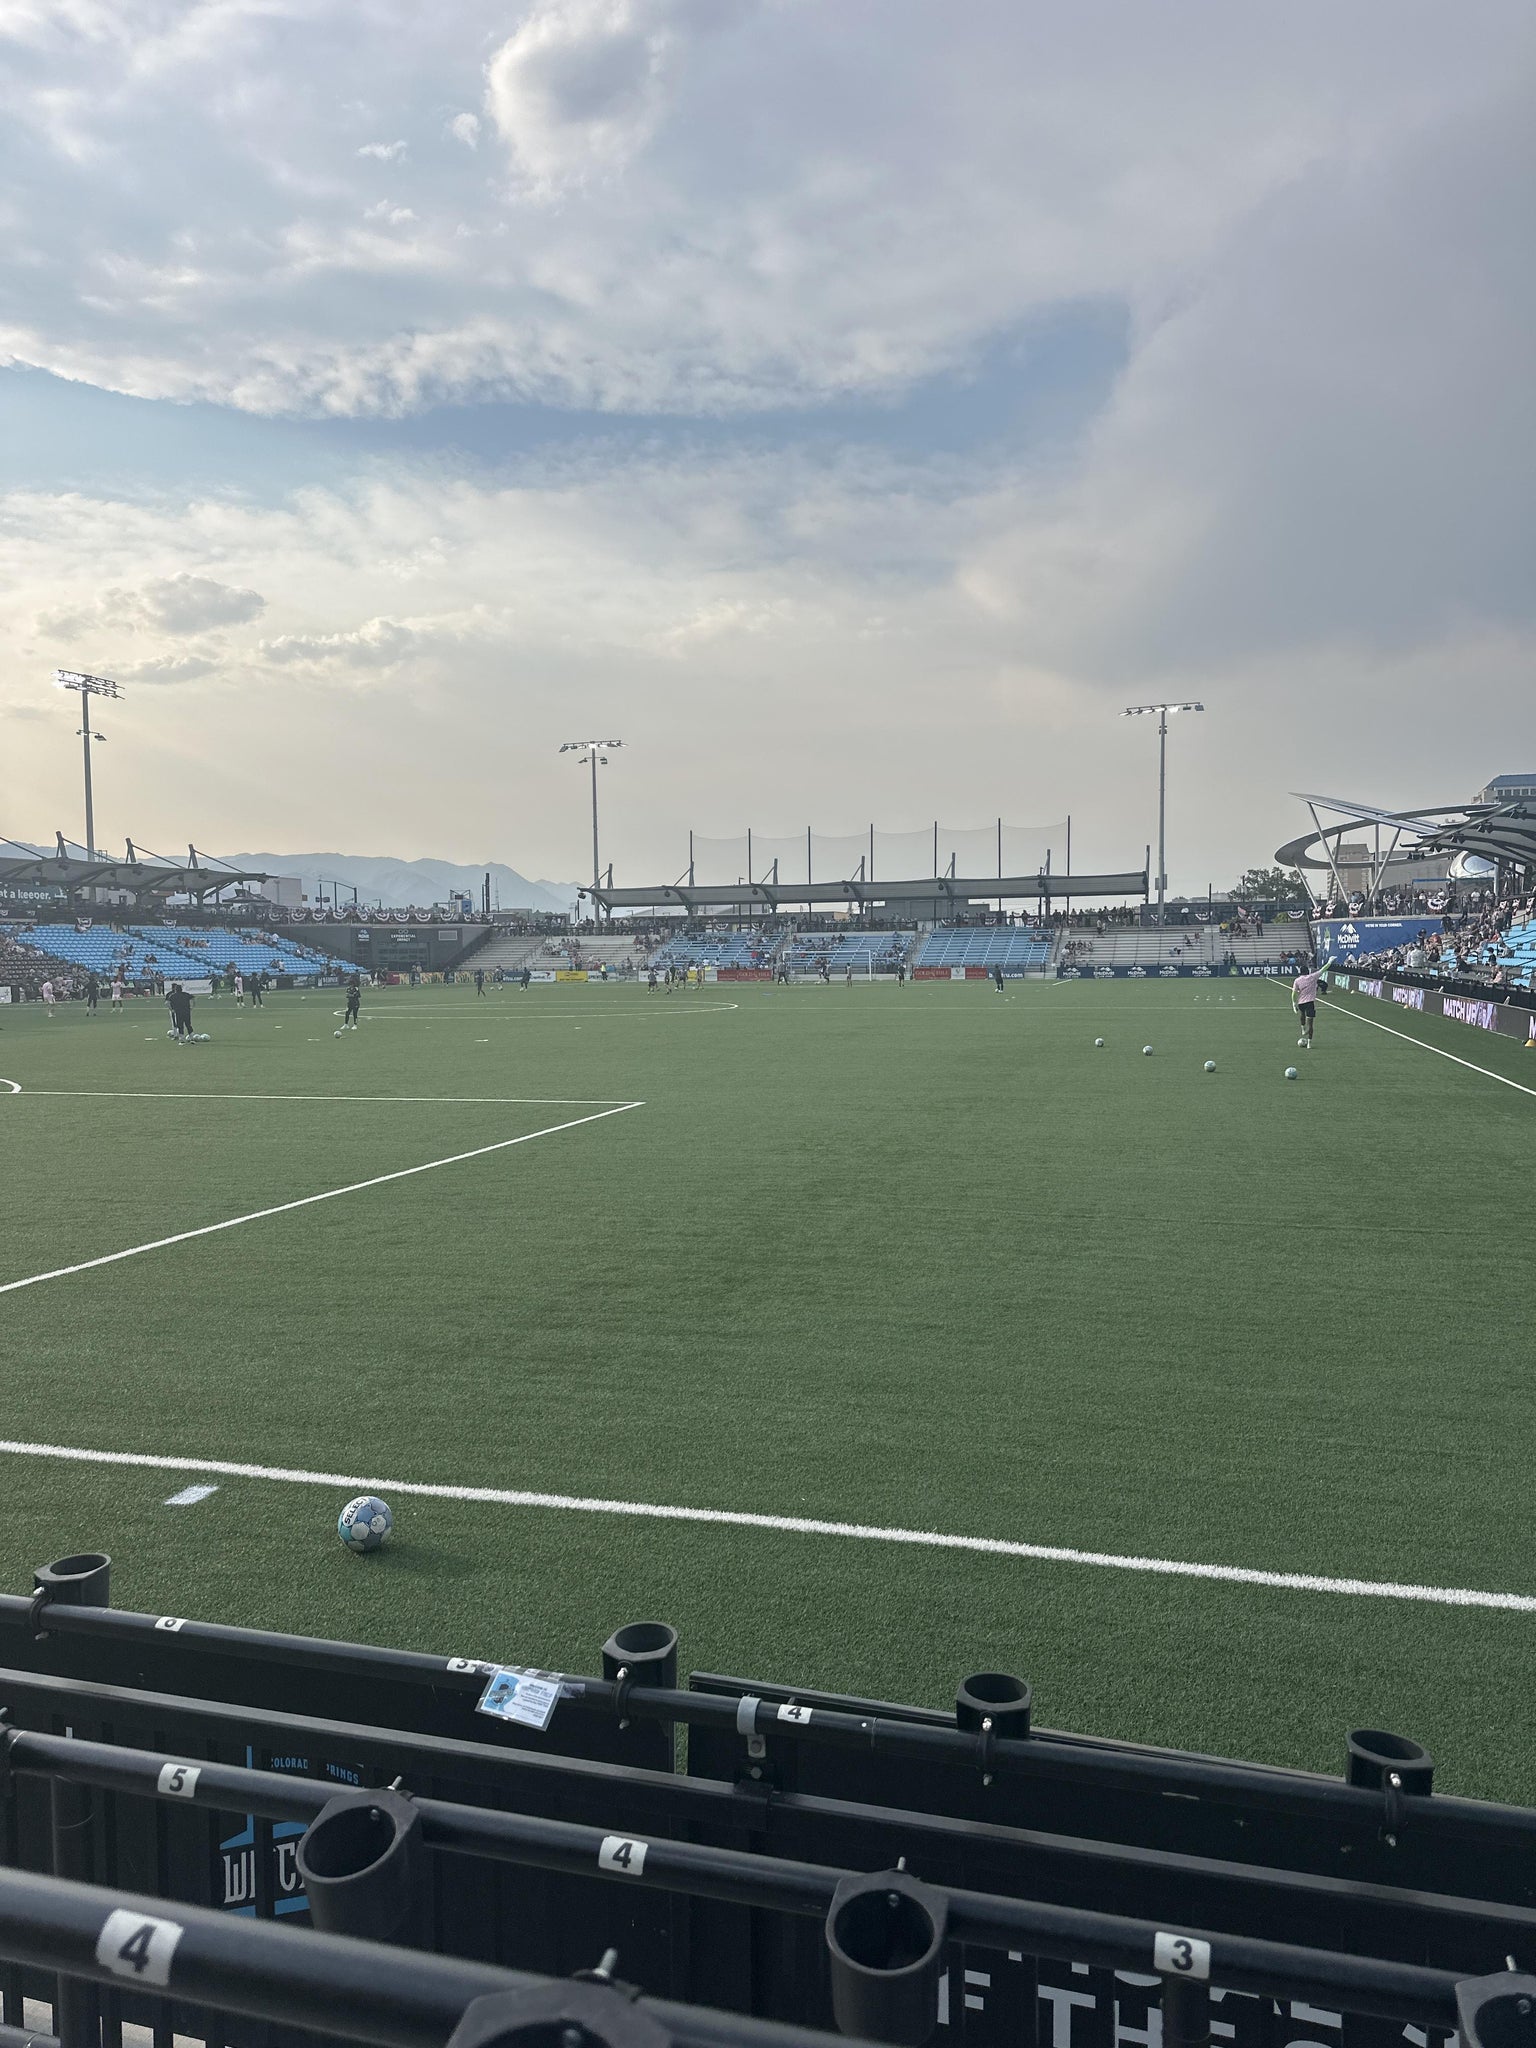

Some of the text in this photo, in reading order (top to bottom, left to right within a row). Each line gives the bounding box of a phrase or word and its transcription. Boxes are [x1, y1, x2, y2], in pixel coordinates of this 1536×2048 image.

[1337, 933, 1360, 944] McDivitt
[1242, 966, 1278, 976] WE'RE
[1280, 966, 1293, 975] IN
[1443, 997, 1466, 1021] MATCH
[787, 1706, 802, 1720] 4
[169, 1767, 188, 1793] 5
[612, 1842, 633, 1869] 4
[118, 1923, 158, 1974] 4
[1171, 1939, 1193, 1971] 3
